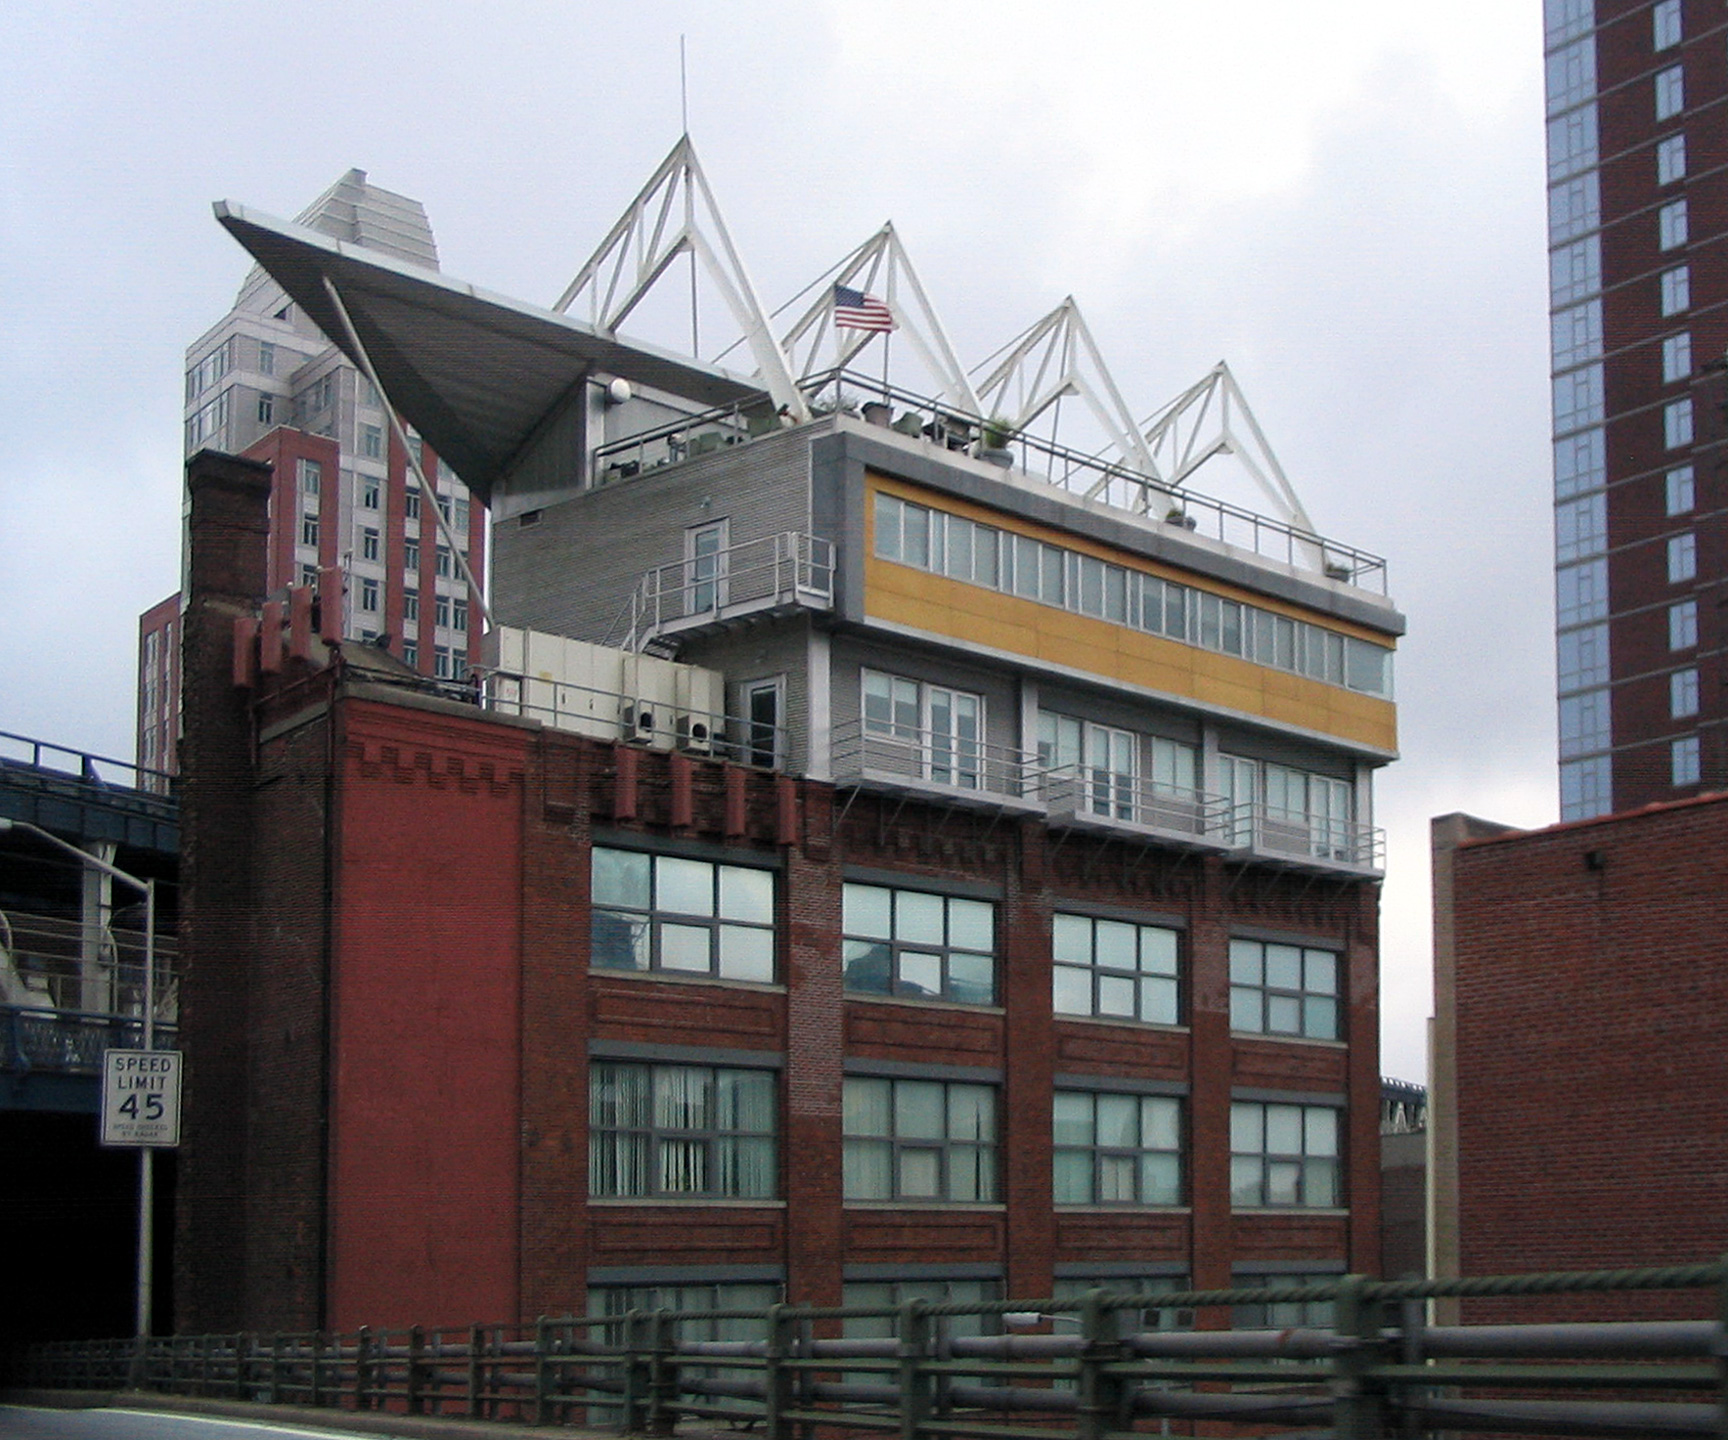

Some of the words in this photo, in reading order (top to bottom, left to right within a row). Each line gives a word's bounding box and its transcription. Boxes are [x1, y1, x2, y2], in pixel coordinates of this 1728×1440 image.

[115, 1057, 171, 1072] SPEED
[118, 1076, 166, 1090] LIMIT
[119, 1093, 164, 1120] 45
